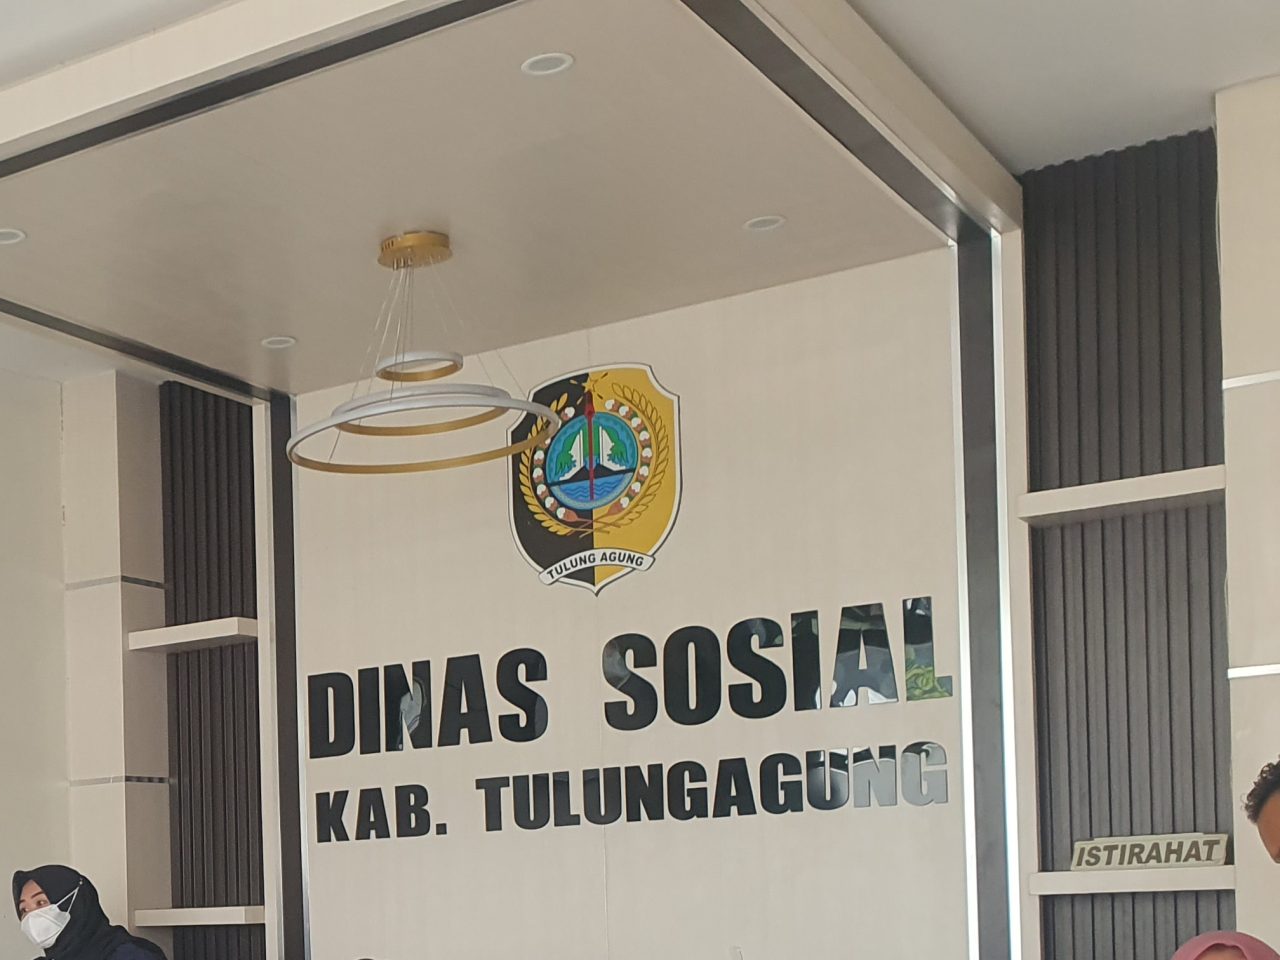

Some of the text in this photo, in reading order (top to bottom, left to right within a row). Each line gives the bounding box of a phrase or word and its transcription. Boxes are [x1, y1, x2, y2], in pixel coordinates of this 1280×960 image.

[546, 551, 644, 580] TULUNG AGUNG
[307, 596, 953, 759] DINAS SOSIAL
[315, 740, 949, 843] KAB. TULUNGAGUNG
[1076, 839, 1220, 867] ISTIRAHAT
